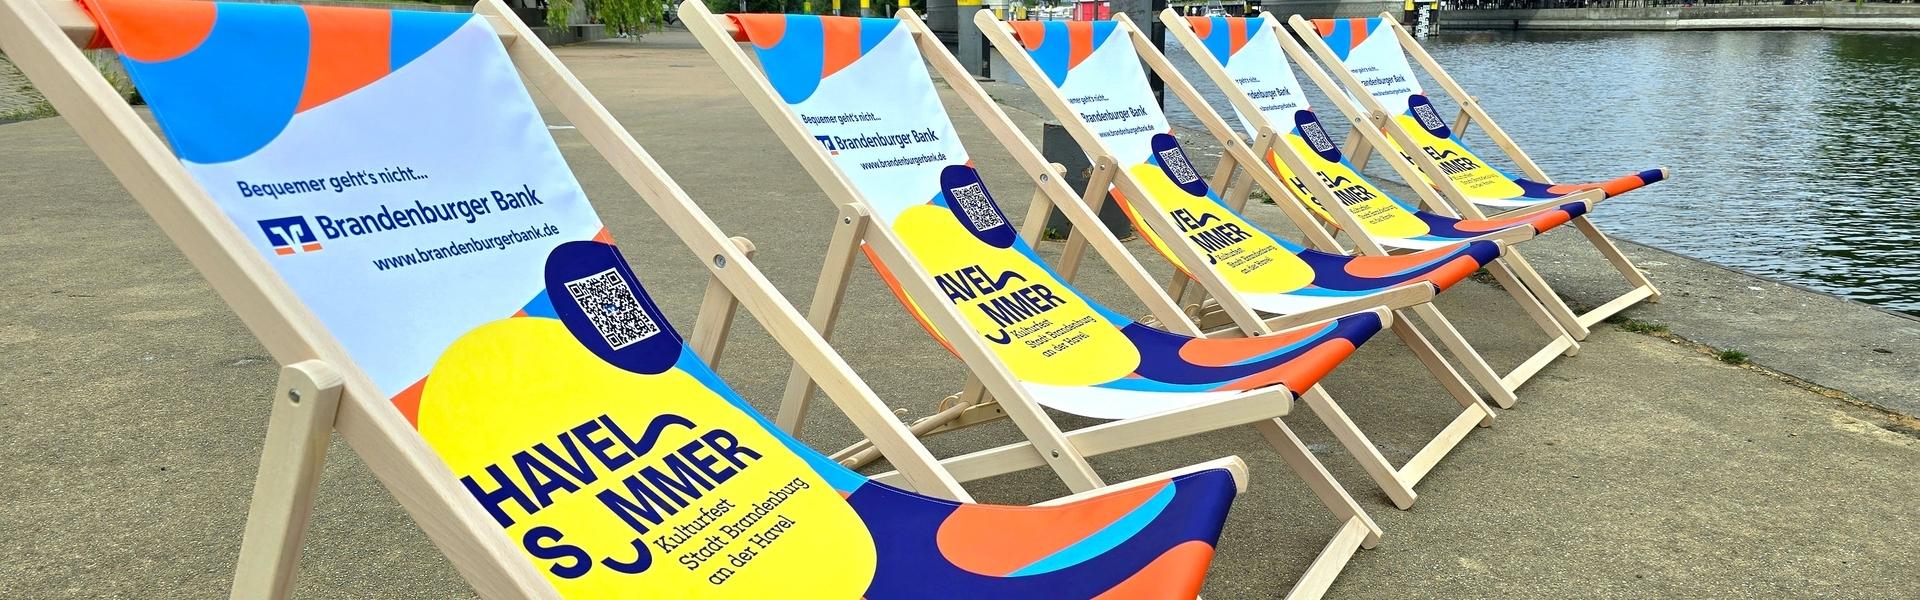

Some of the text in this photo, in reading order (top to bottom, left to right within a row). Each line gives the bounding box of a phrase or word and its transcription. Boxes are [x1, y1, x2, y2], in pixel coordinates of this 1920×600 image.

[801, 113, 838, 126] Bequemer
[1129, 104, 1148, 117] Bank
[833, 127, 940, 150] Brandenburger Bank
[860, 152, 947, 170] www.brandenburgerbank.de
[237, 167, 428, 199] Bequemer geht's nicht...
[315, 184, 544, 240] Brandenburger Bank
[372, 223, 560, 272] www.brandenburgerbank.de
[934, 264, 1028, 304] AVEL
[1010, 318, 1053, 339] Kulturfest
[459, 413, 697, 529] HAVEL
[653, 498, 736, 554] Kulturfest
[678, 477, 810, 571] Stadt Brandenburg
[708, 514, 796, 585] an der Havel
